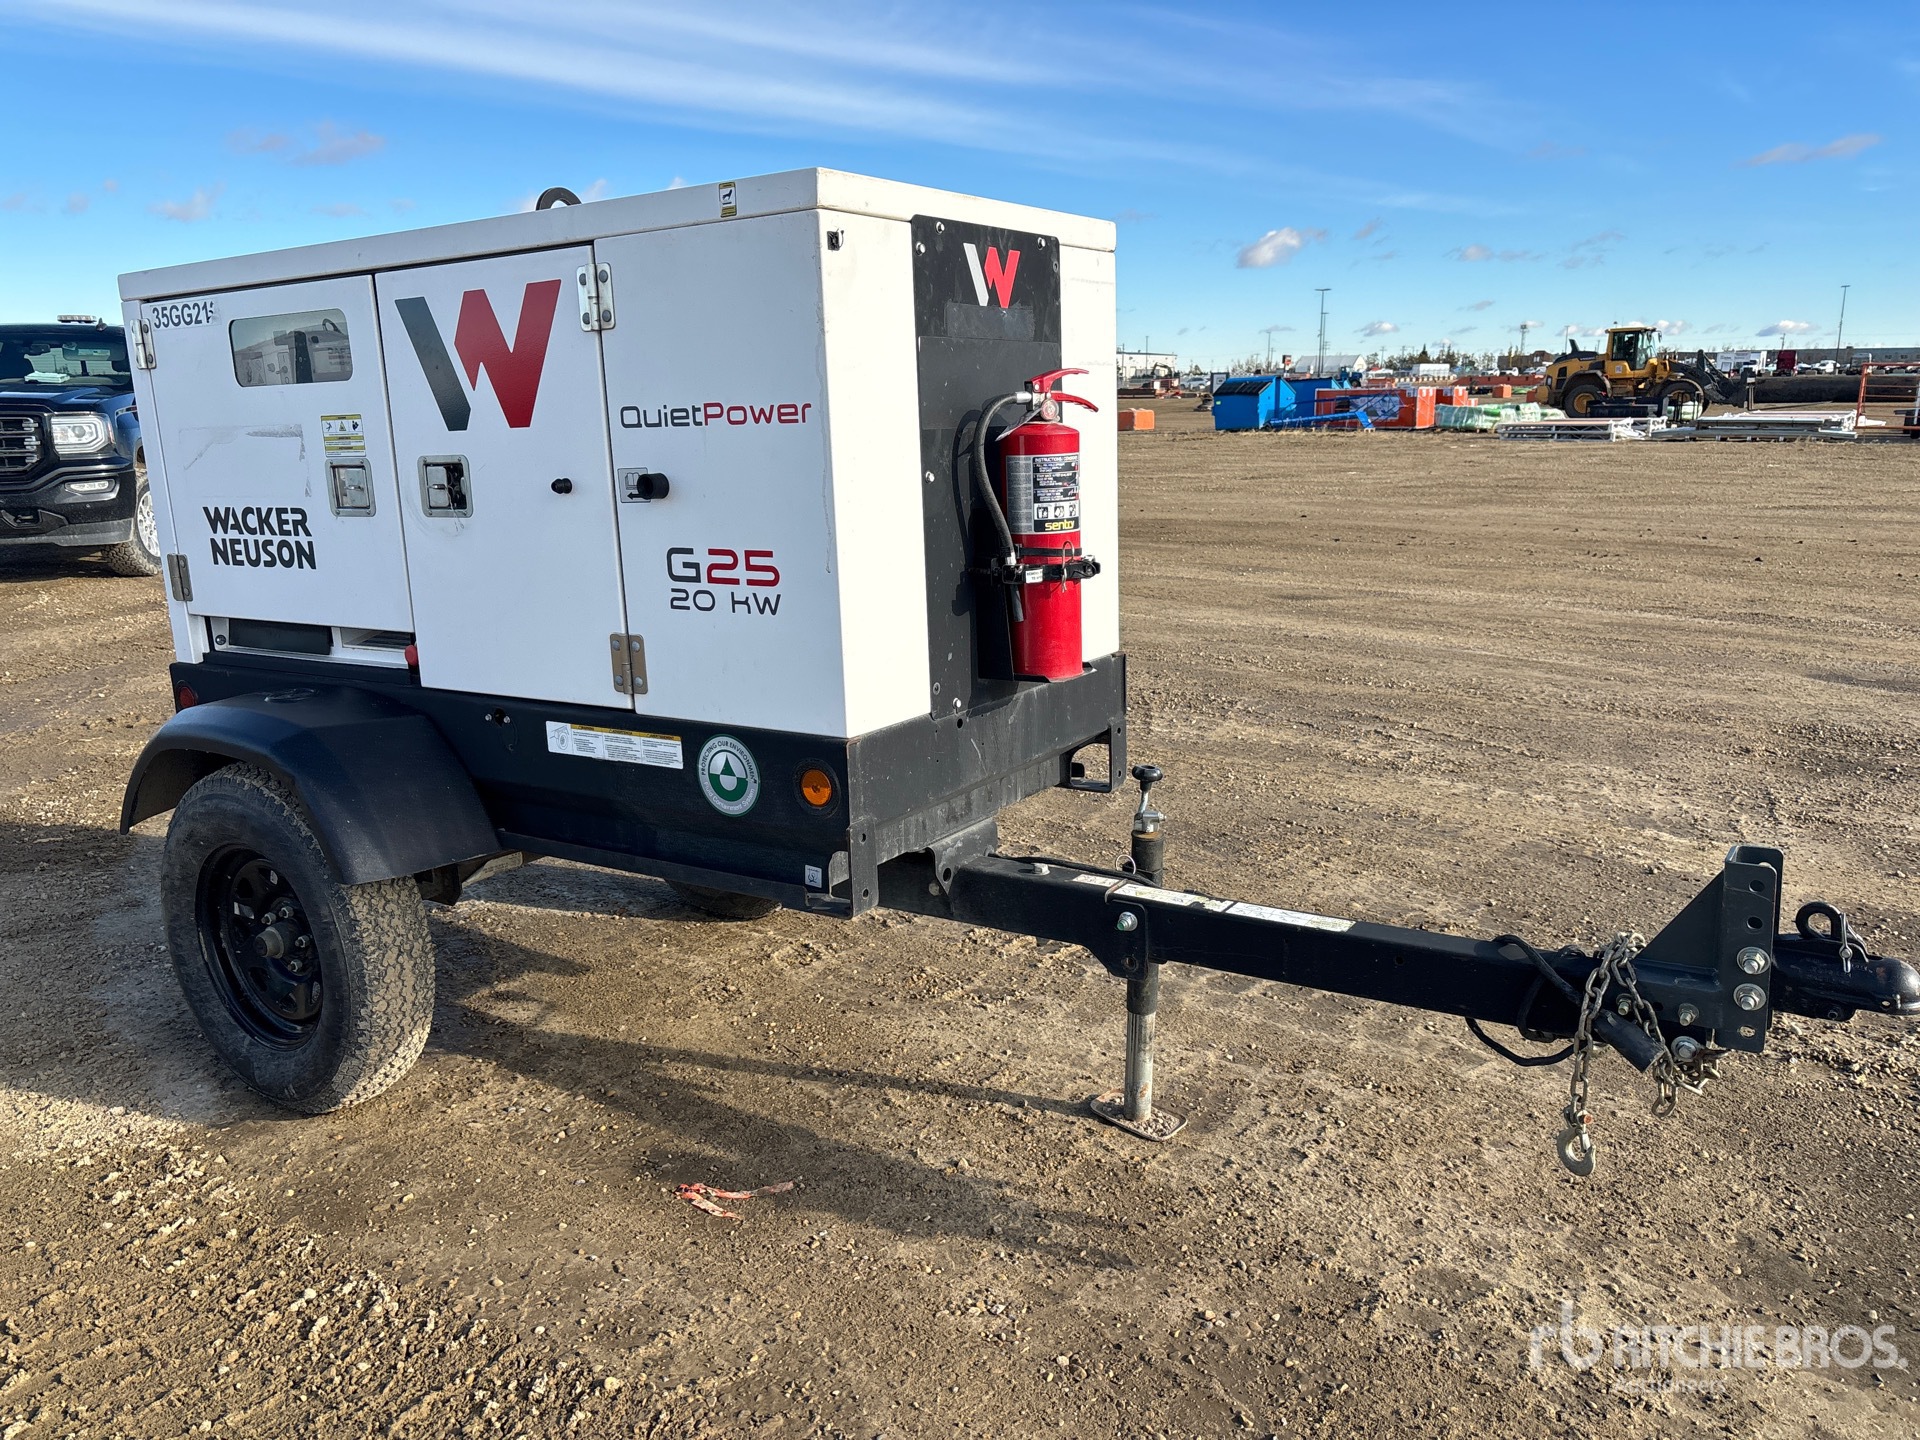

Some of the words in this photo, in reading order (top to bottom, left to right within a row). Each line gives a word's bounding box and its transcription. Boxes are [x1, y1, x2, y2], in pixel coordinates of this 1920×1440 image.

[620, 402, 812, 428] QuietPower
[203, 506, 312, 537] WACKER
[1045, 519, 1075, 531] sentry
[210, 538, 316, 569] NEUSON
[666, 547, 781, 587] G25
[670, 588, 716, 611] 20
[701, 742, 717, 775] PROTECTING
